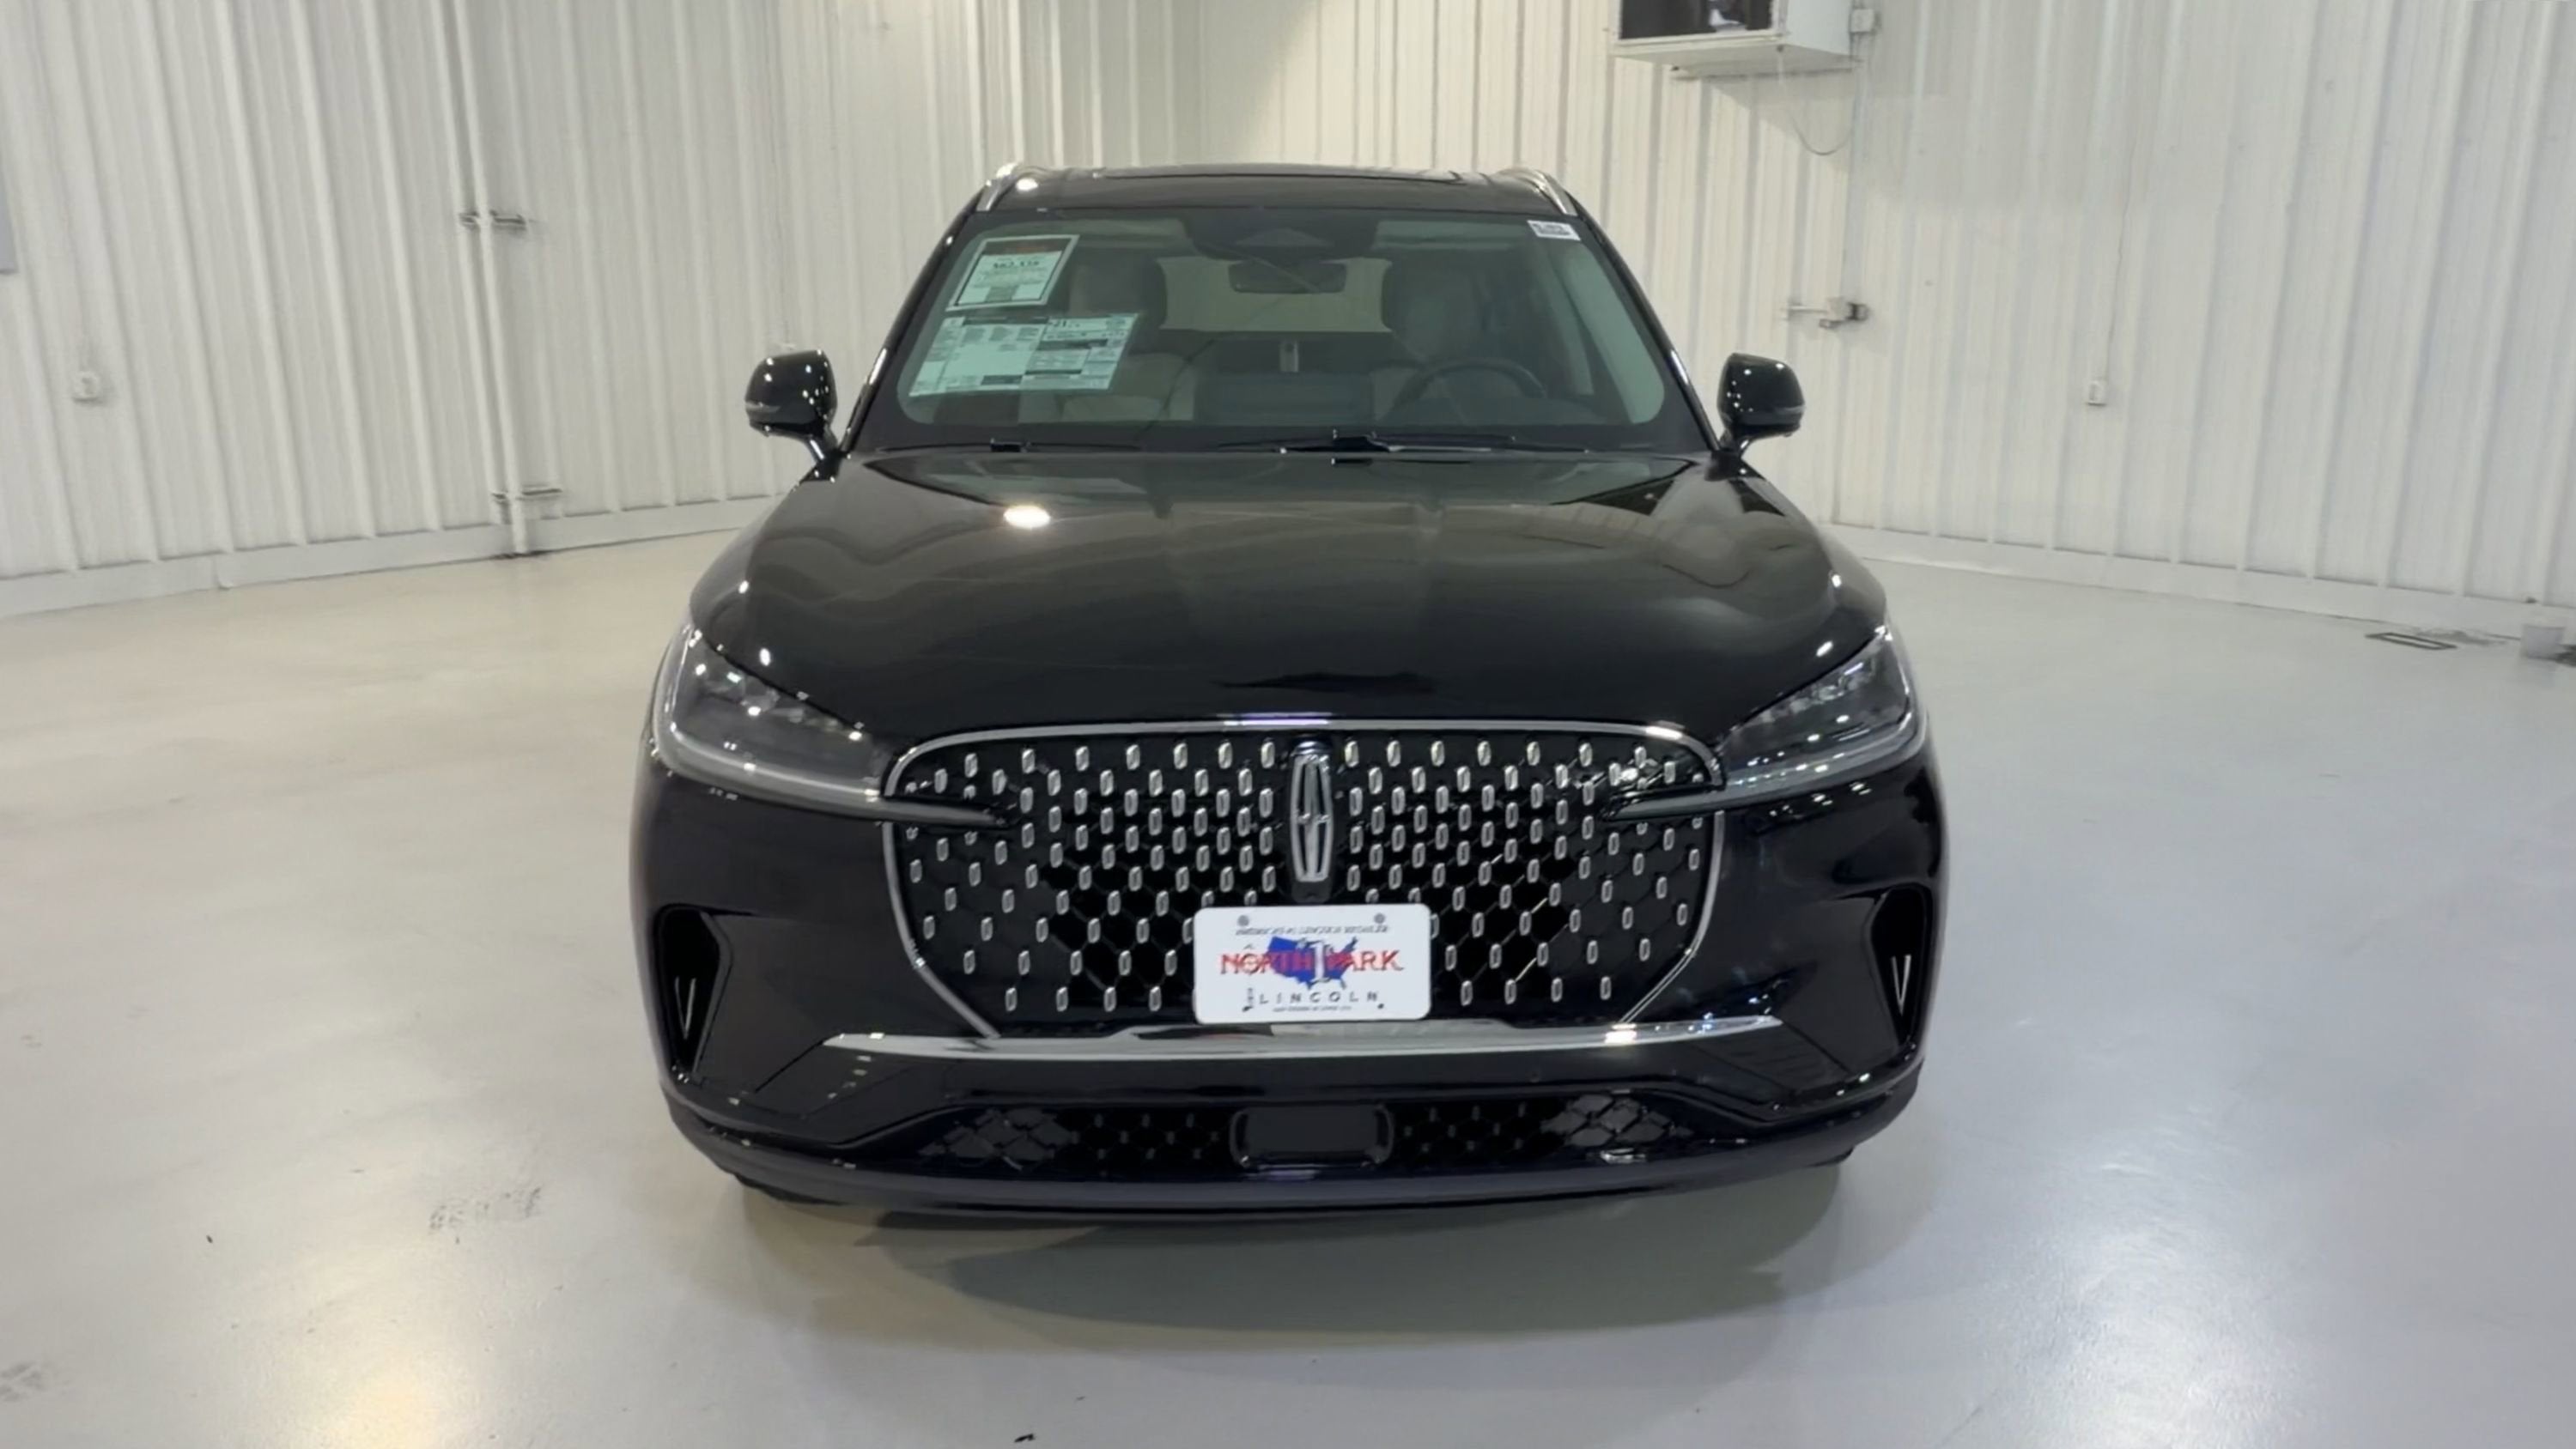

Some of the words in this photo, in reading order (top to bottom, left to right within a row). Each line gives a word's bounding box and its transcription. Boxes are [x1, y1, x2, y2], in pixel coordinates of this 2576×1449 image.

[1220, 949, 1312, 975] NORTH
[1326, 949, 1404, 973] PARK
[1259, 991, 1379, 1004] LINCOLN
